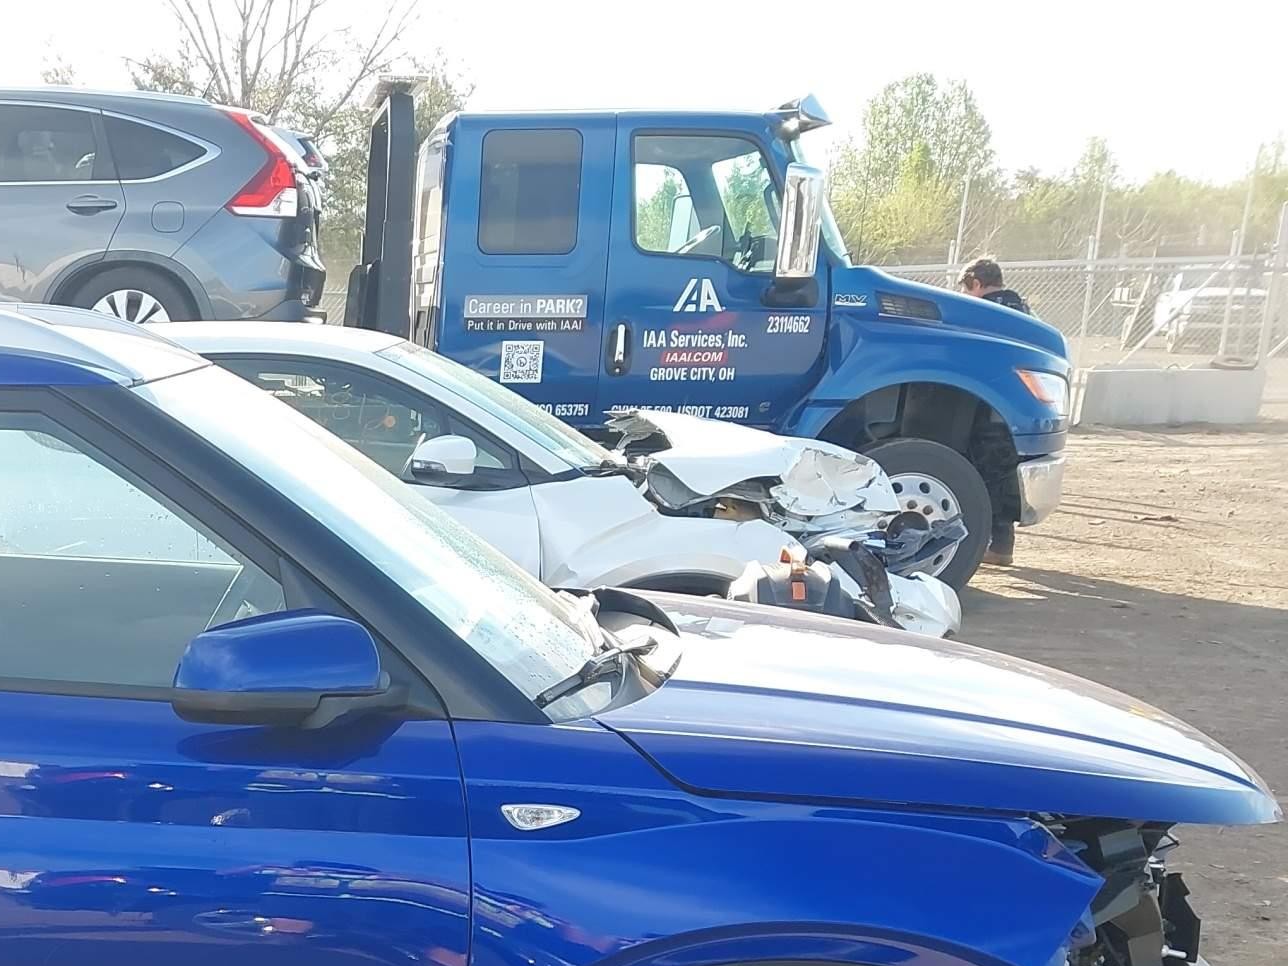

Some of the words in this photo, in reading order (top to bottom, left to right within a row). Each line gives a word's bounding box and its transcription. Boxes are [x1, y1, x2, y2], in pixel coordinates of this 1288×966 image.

[468, 299, 515, 314] Career
[520, 299, 532, 314] in
[536, 299, 583, 314] PARK?
[467, 320, 484, 331] Put
[487, 320, 494, 331] it
[496, 320, 505, 331] in
[508, 320, 532, 331] Drive
[536, 320, 557, 331] with
[560, 320, 582, 331] IAAI
[766, 316, 811, 333] 23114662
[643, 330, 667, 348] IAA
[670, 330, 725, 349] Services,
[727, 330, 748, 348] Inc.
[665, 351, 724, 363] IAAI.COM
[650, 367, 687, 381] GROVE
[690, 367, 716, 383] CITY,
[719, 367, 736, 381] OH
[555, 403, 589, 416] 653751
[677, 405, 713, 418] USDOT
[714, 406, 749, 418] 423081
